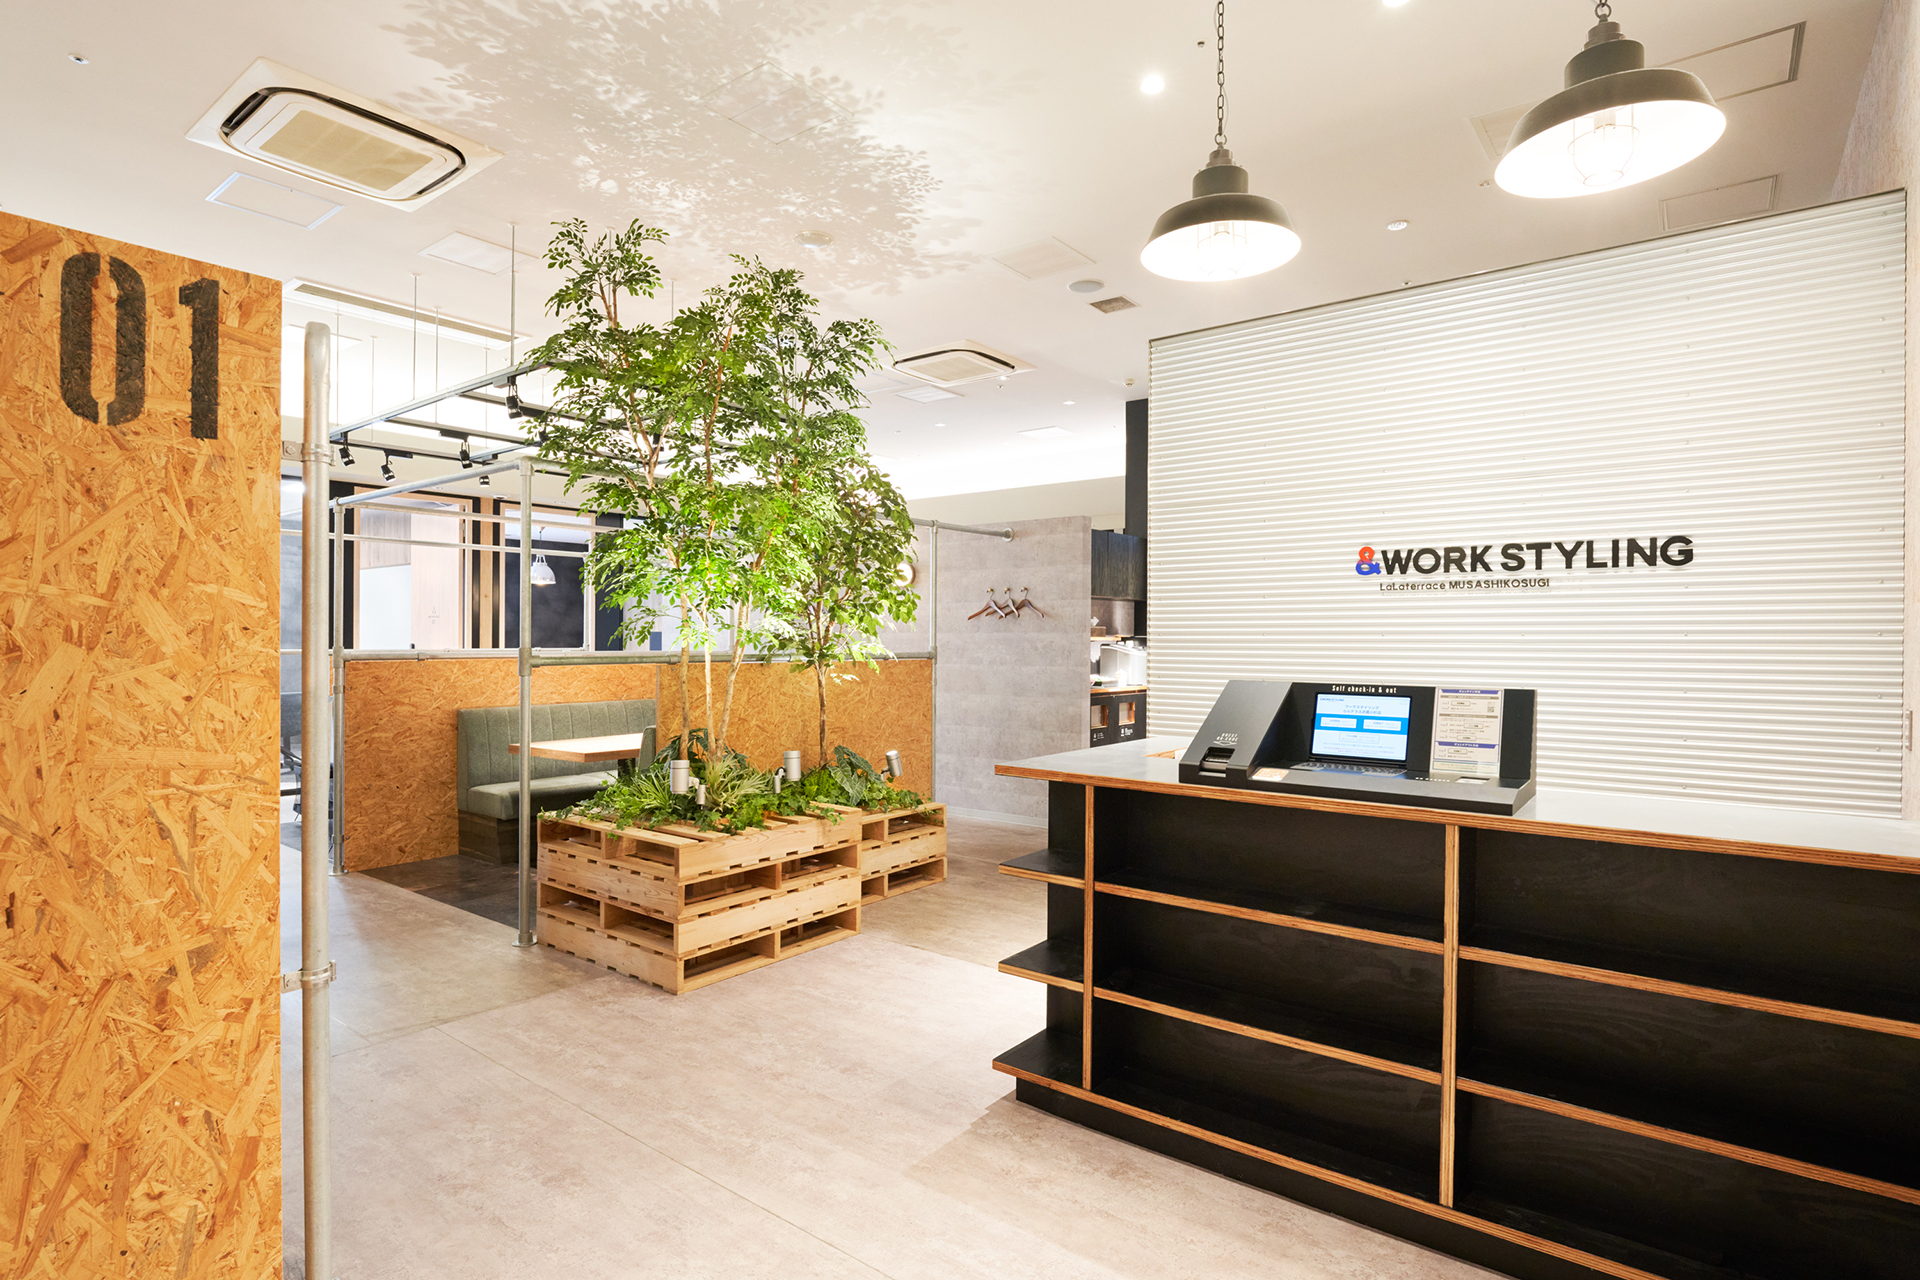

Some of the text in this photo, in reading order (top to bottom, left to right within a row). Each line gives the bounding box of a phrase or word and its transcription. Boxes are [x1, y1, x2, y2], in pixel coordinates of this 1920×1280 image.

[60, 252, 219, 440] 01
[1500, 535, 1694, 572] STYLING
[1380, 578, 1550, 592] LaLaterrace MUSASHIKOSUGI
[1332, 684, 1345, 692] Self
[1347, 685, 1375, 693] check-in
